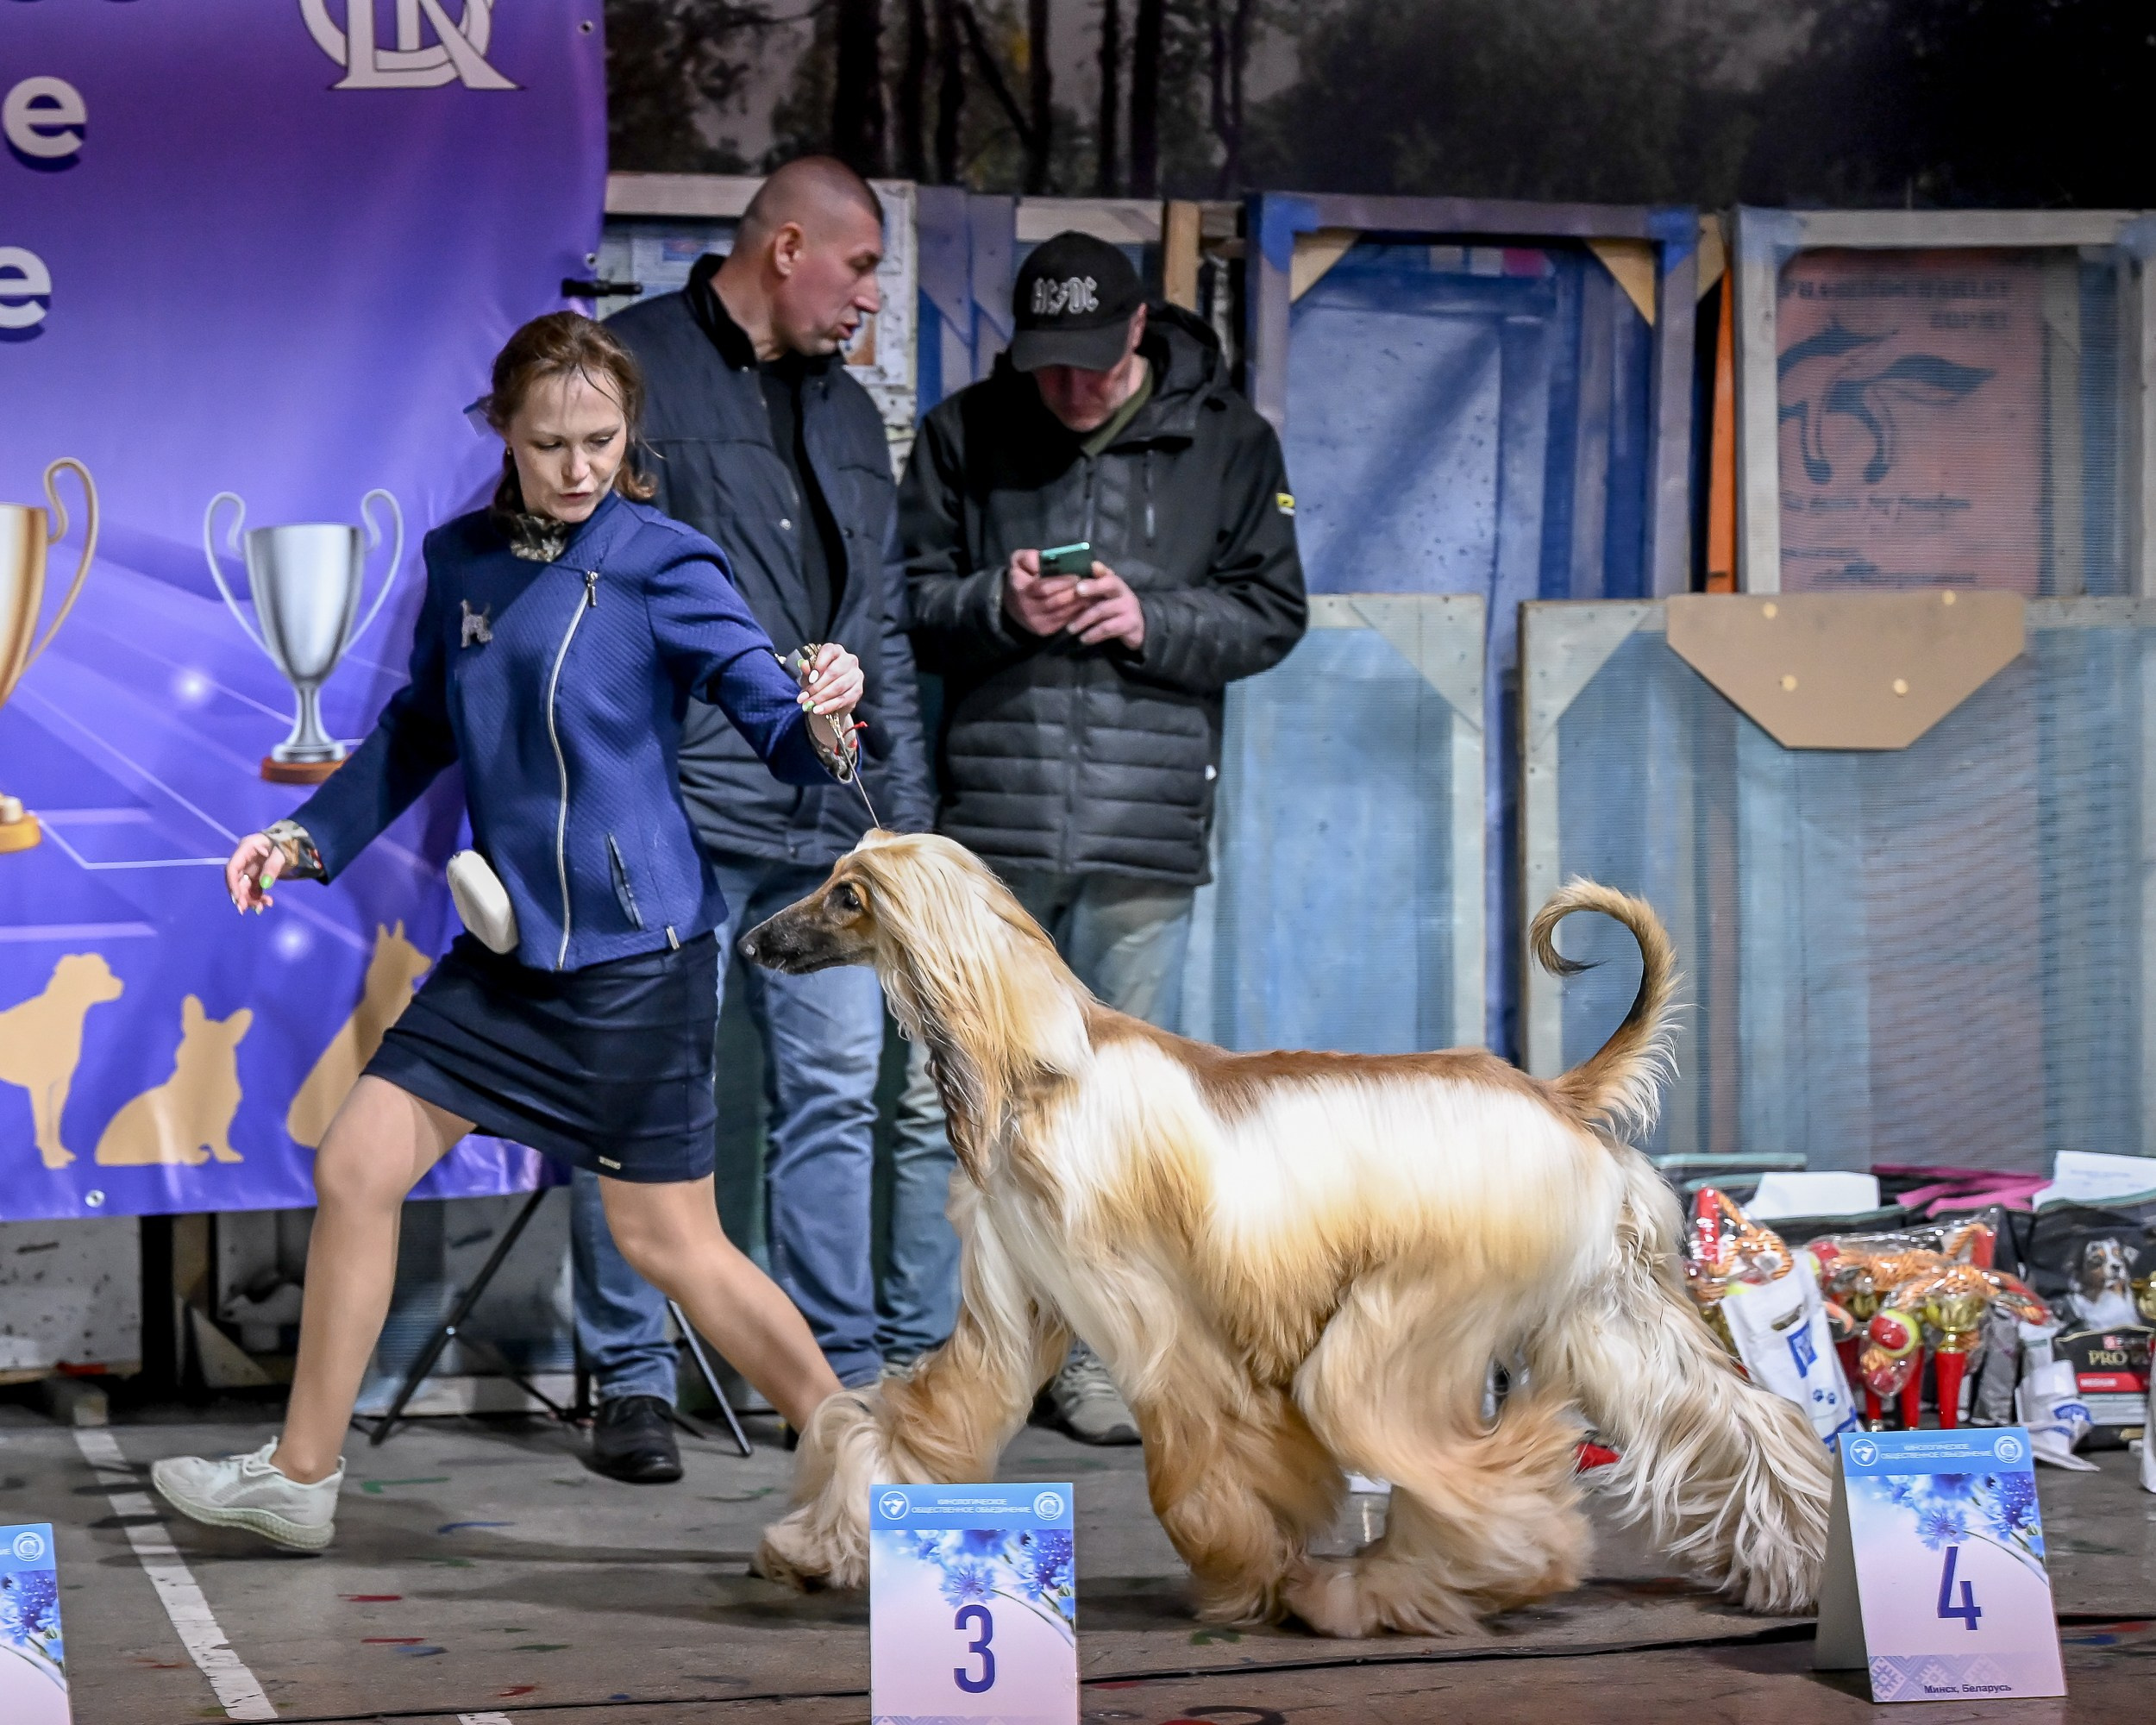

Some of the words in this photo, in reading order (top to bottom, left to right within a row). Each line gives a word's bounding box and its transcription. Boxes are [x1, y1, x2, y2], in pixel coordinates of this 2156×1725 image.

[2088, 1350, 2128, 1366] PRO
[1937, 1546, 1982, 1630] 4
[953, 1604, 996, 1693] 3
[1962, 1684, 2012, 1693] Беларусь
